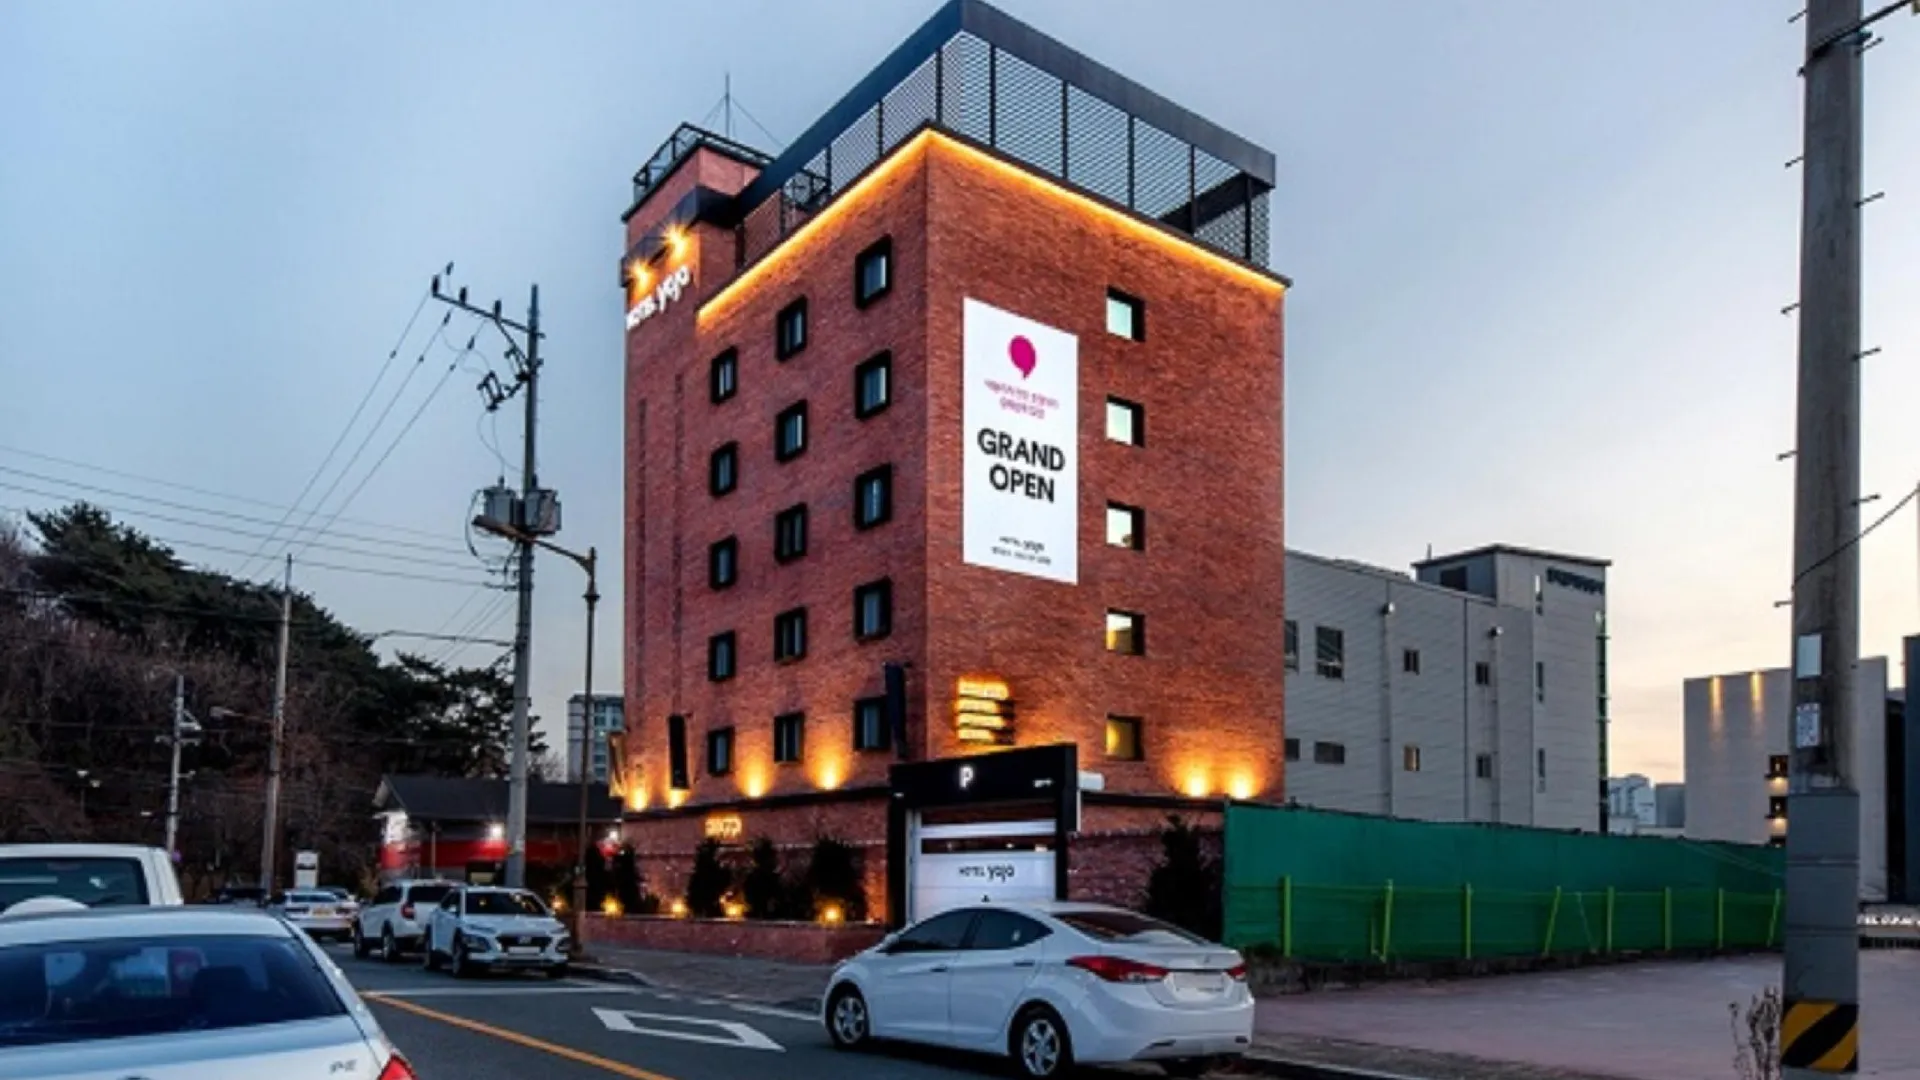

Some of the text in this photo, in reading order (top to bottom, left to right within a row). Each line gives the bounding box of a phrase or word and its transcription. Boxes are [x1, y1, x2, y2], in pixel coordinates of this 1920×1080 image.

[977, 427, 1065, 472] GRAND
[989, 463, 1054, 503] OPEN
[958, 766, 974, 789] P
